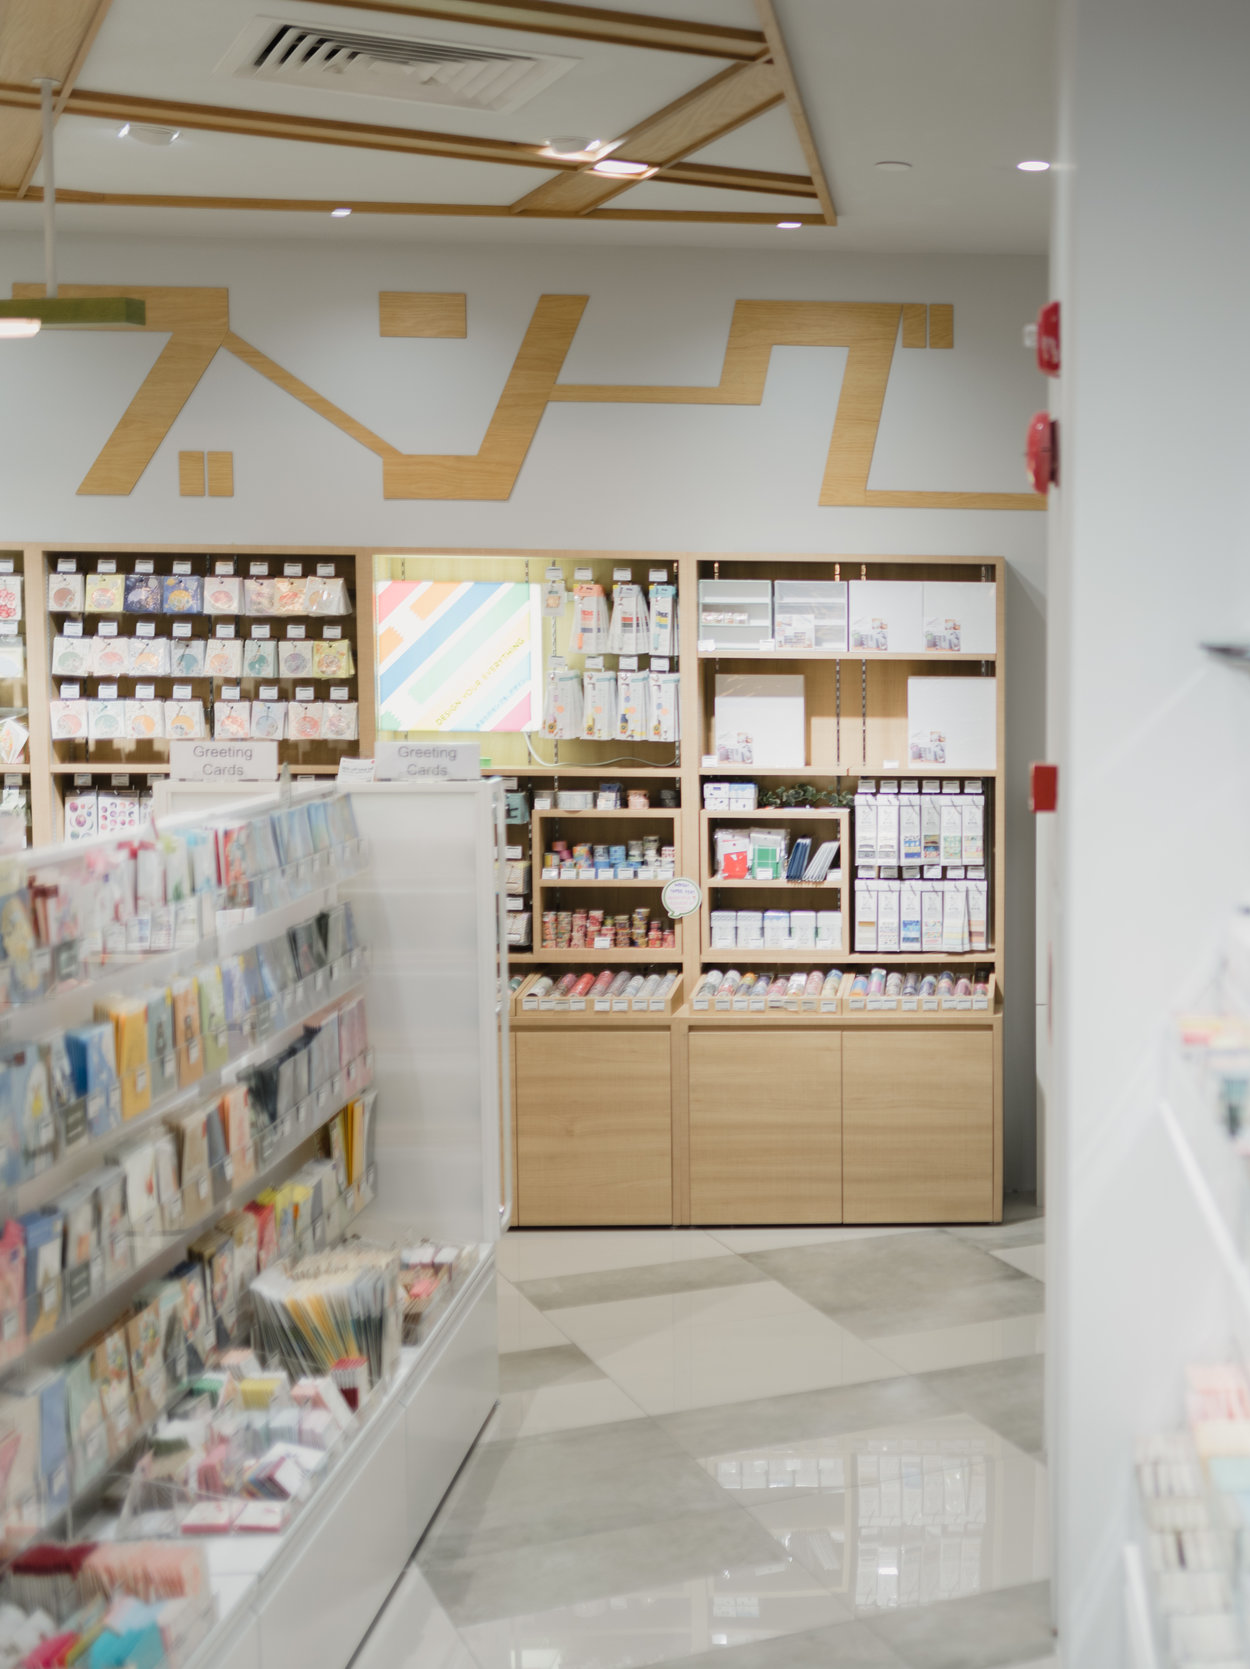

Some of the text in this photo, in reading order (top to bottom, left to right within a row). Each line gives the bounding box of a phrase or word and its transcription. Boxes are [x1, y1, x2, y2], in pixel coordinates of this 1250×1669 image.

[435, 700, 462, 726] DESIGN
[462, 679, 481, 699] YOUR
[193, 745, 253, 761] Greeting
[397, 745, 457, 761] Greeting
[202, 763, 244, 776] Cards
[407, 763, 448, 776] Cards
